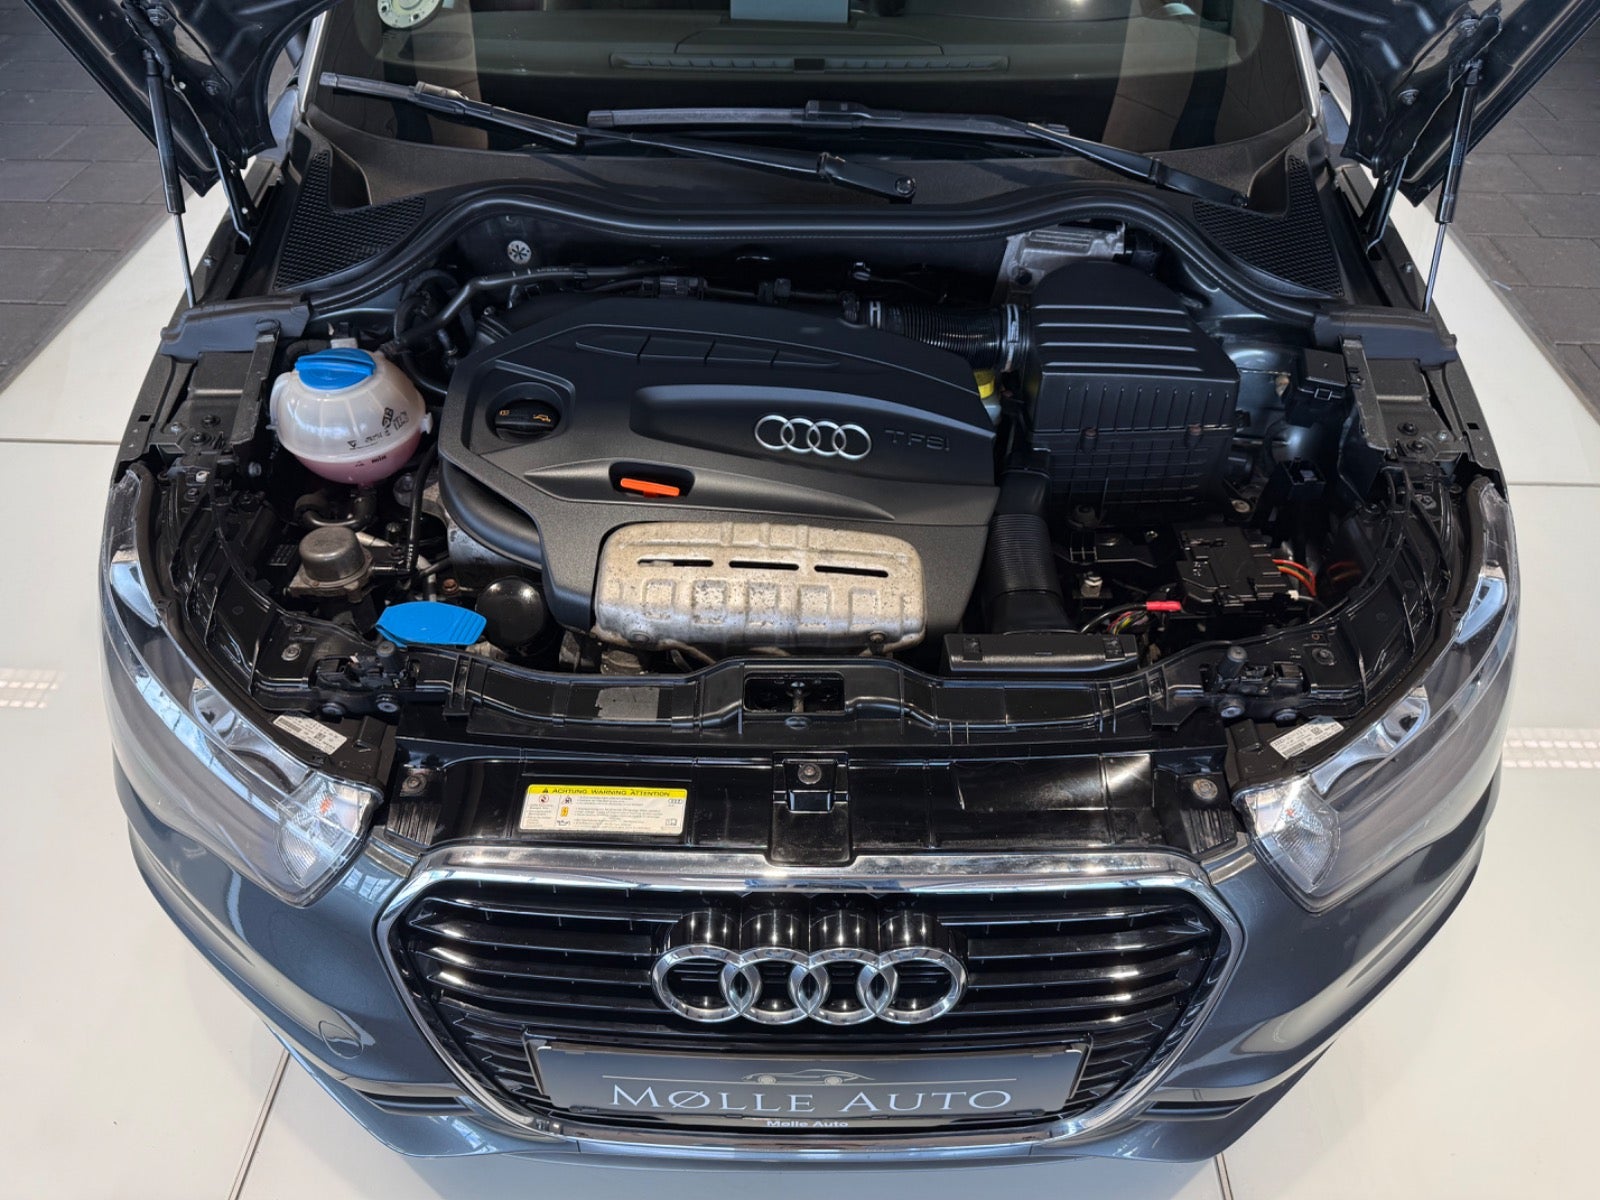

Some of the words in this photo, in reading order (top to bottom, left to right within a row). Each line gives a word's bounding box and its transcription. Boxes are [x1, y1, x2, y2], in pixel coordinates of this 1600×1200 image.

[551, 787, 588, 795] ACHTUNG
[630, 789, 671, 798] ATTENTION
[608, 1084, 816, 1113] MØLLE
[838, 1090, 1012, 1113] AUTO
[812, 1120, 849, 1128] Auto
